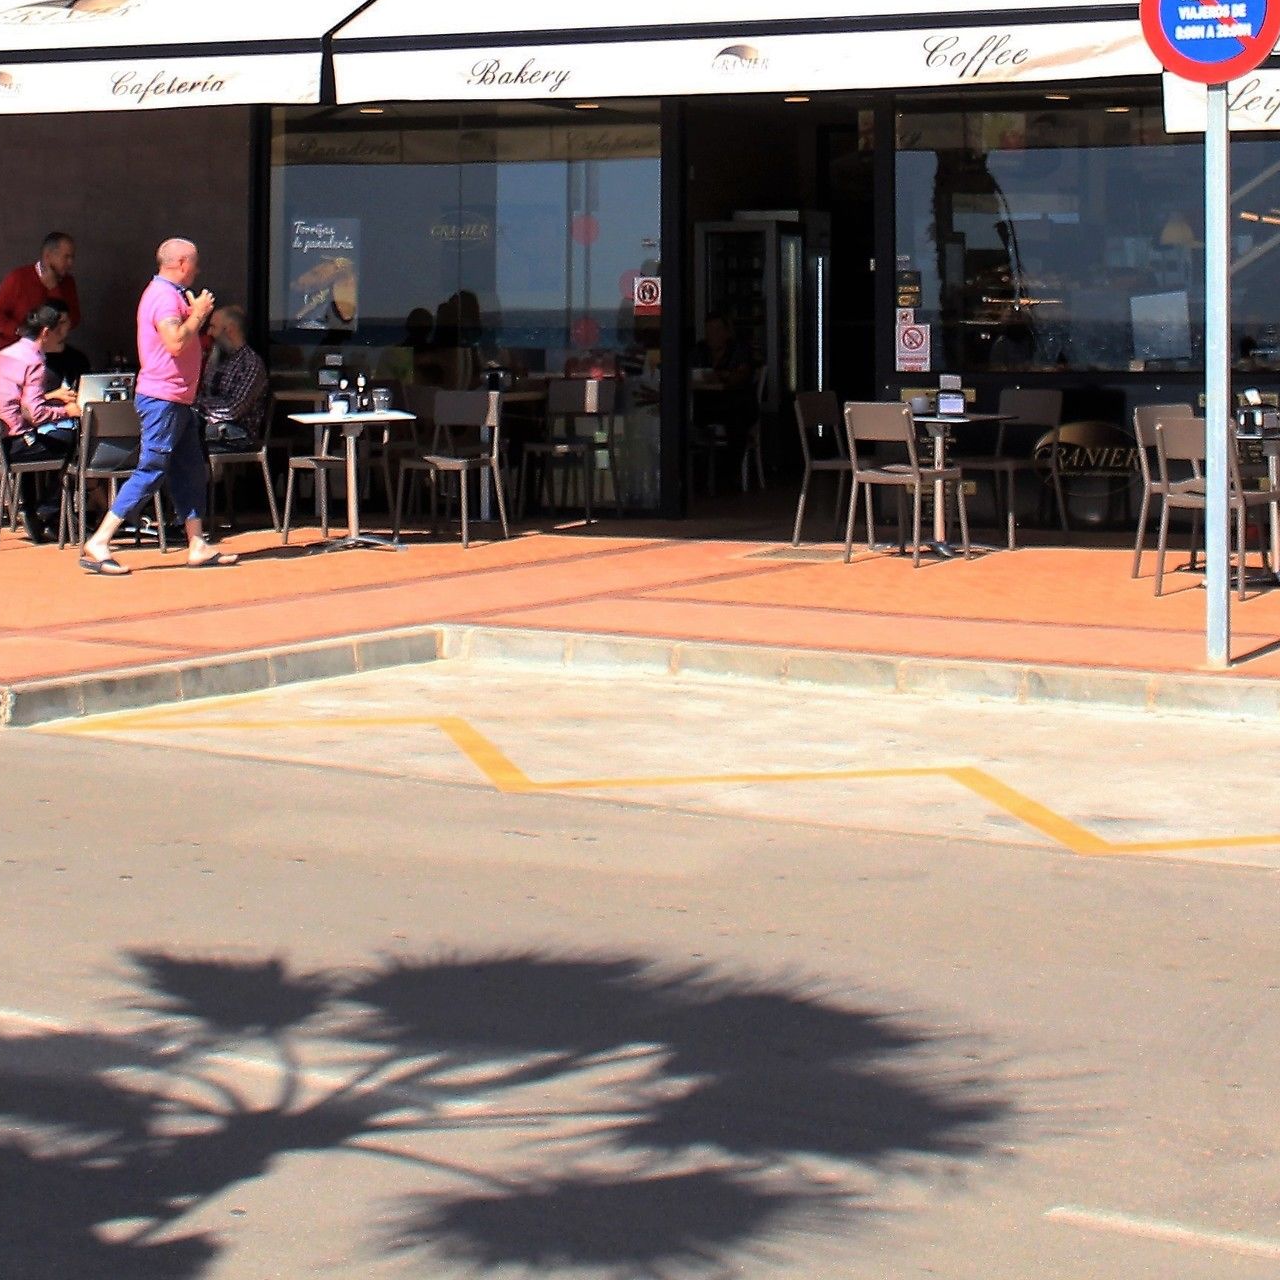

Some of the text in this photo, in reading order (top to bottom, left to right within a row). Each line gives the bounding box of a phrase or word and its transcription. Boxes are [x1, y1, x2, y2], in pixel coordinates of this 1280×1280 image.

[1206, 25, 1215, 38] A
[923, 34, 1031, 78] Coffee
[111, 70, 226, 104] Cafetería
[467, 58, 571, 93] Bakery
